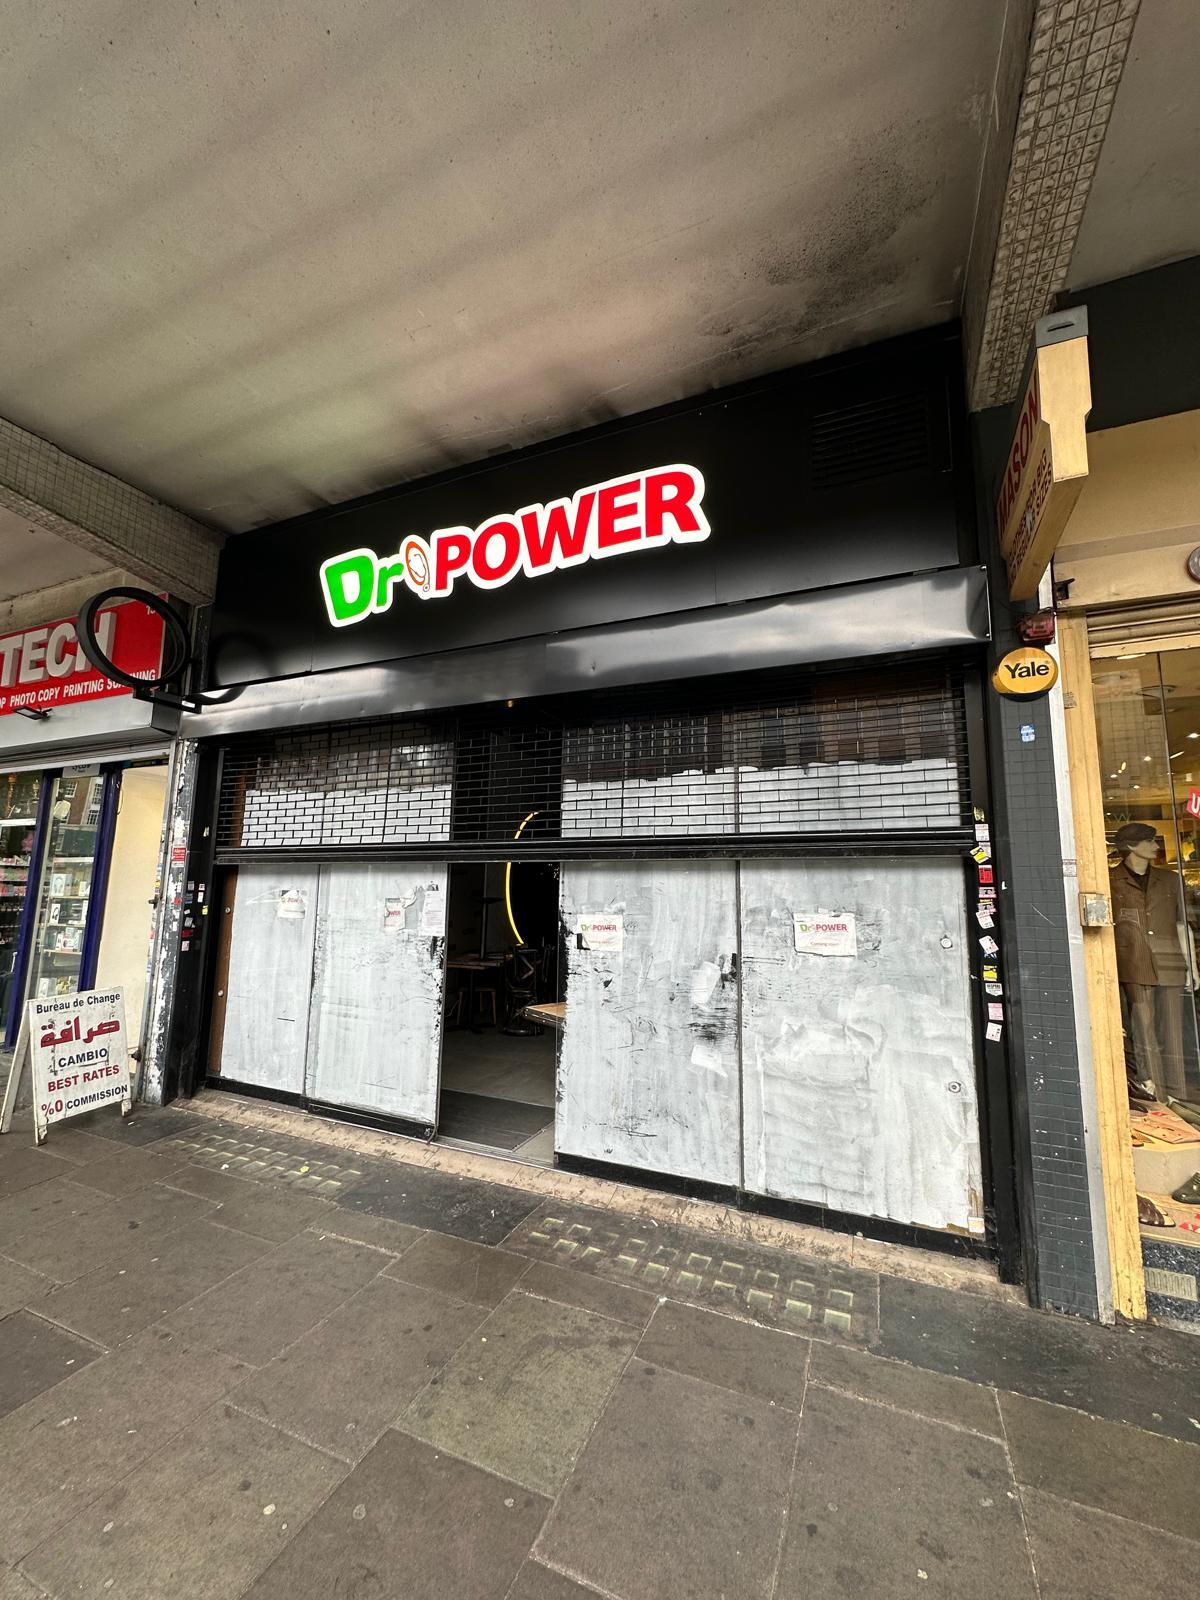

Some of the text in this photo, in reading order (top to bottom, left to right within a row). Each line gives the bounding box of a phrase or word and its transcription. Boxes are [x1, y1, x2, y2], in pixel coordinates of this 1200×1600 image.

[324, 470, 701, 621] Dr POWER
[1004, 661, 1050, 679] Yale
[10, 691, 37, 707] PHOTO
[38, 687, 60, 701] COPY
[63, 679, 104, 697] PRINTING
[816, 923, 848, 931] POWER
[36, 993, 121, 1014] Bureau de Change
[40, 1015, 120, 1048] صرافة
[58, 1048, 108, 1068] CAMBIO
[48, 1065, 120, 1092] BEST RATES
[41, 1086, 127, 1116] %0 COMMISSION
